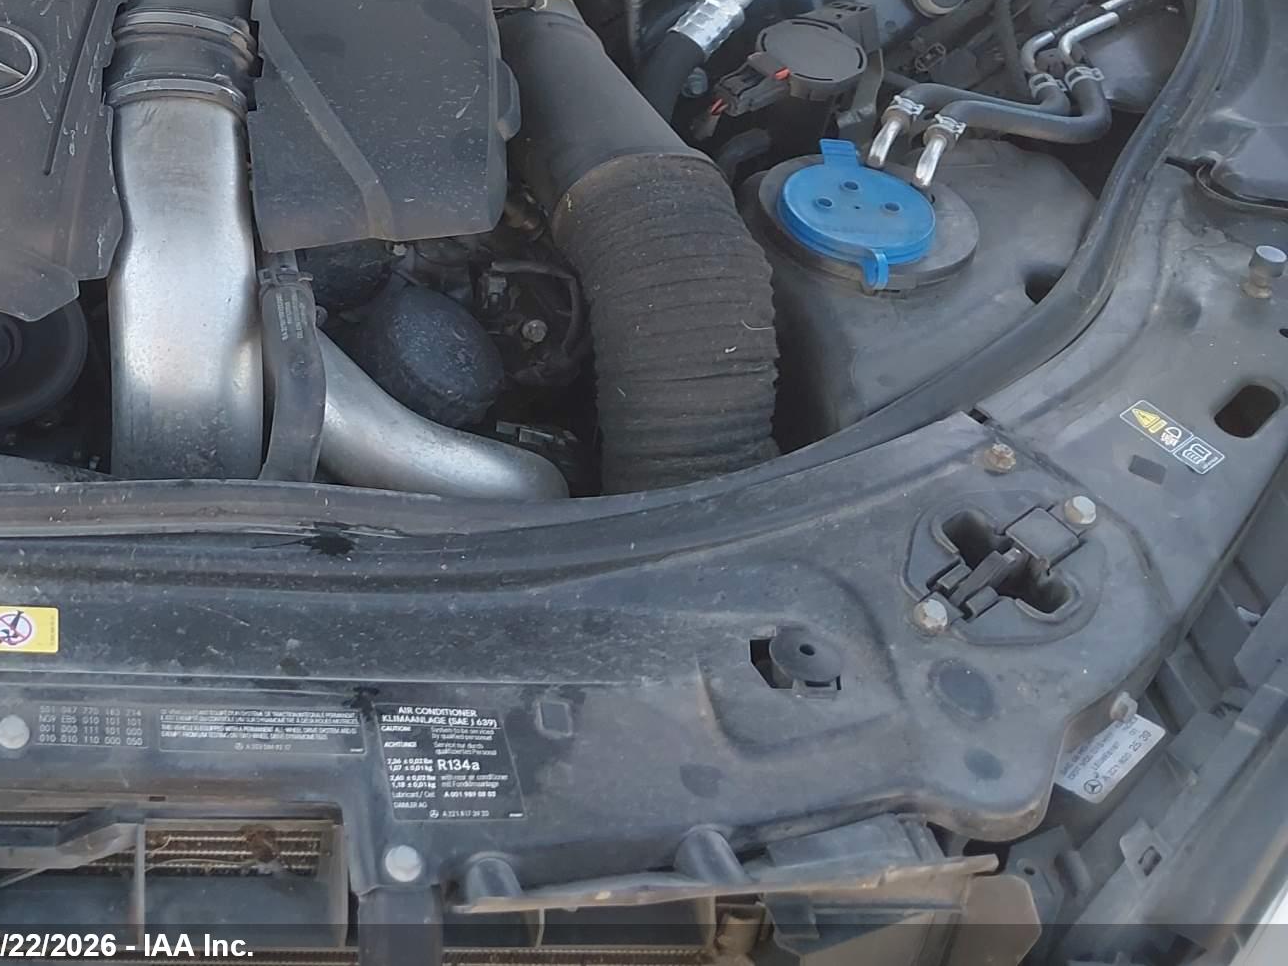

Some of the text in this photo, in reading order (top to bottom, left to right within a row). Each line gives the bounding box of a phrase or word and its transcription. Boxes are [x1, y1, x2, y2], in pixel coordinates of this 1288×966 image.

[399, 706, 477, 717] AIR CONDITIONER
[382, 715, 446, 724] KLIMAANLAGE
[448, 717, 469, 726] (SAE
[476, 719, 497, 728] 639)
[1129, 741, 1142, 753] 25
[437, 759, 480, 771] R134a
